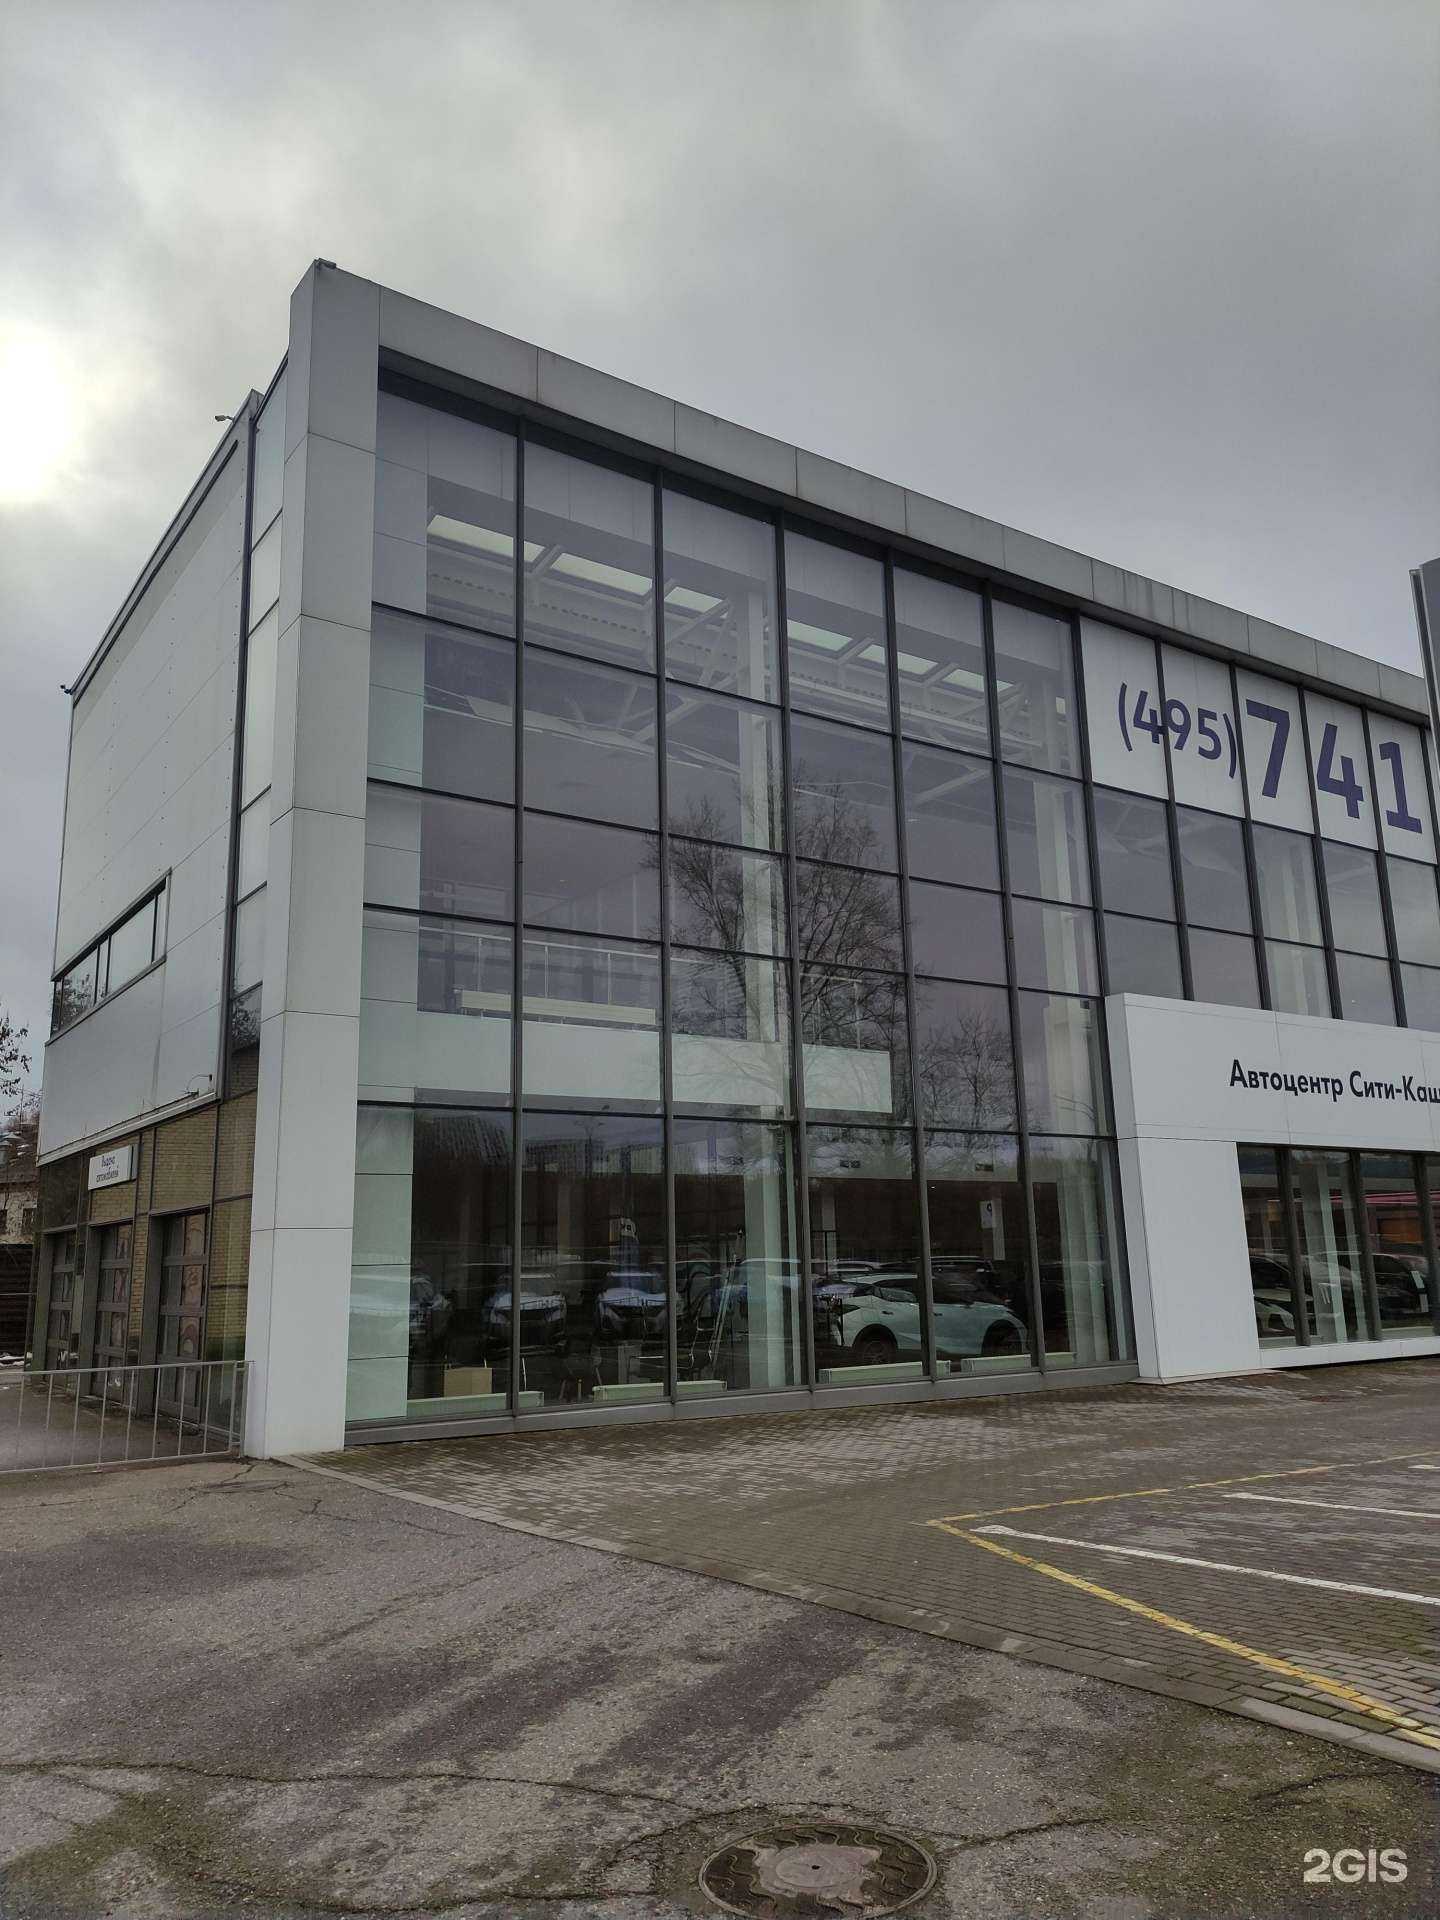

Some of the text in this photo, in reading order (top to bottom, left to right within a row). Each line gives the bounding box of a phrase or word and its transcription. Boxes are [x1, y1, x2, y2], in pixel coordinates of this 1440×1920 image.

[1118, 681, 1423, 834] (495) 741
[1229, 1058, 1440, 1104] Автоцентр Сити-Каш
